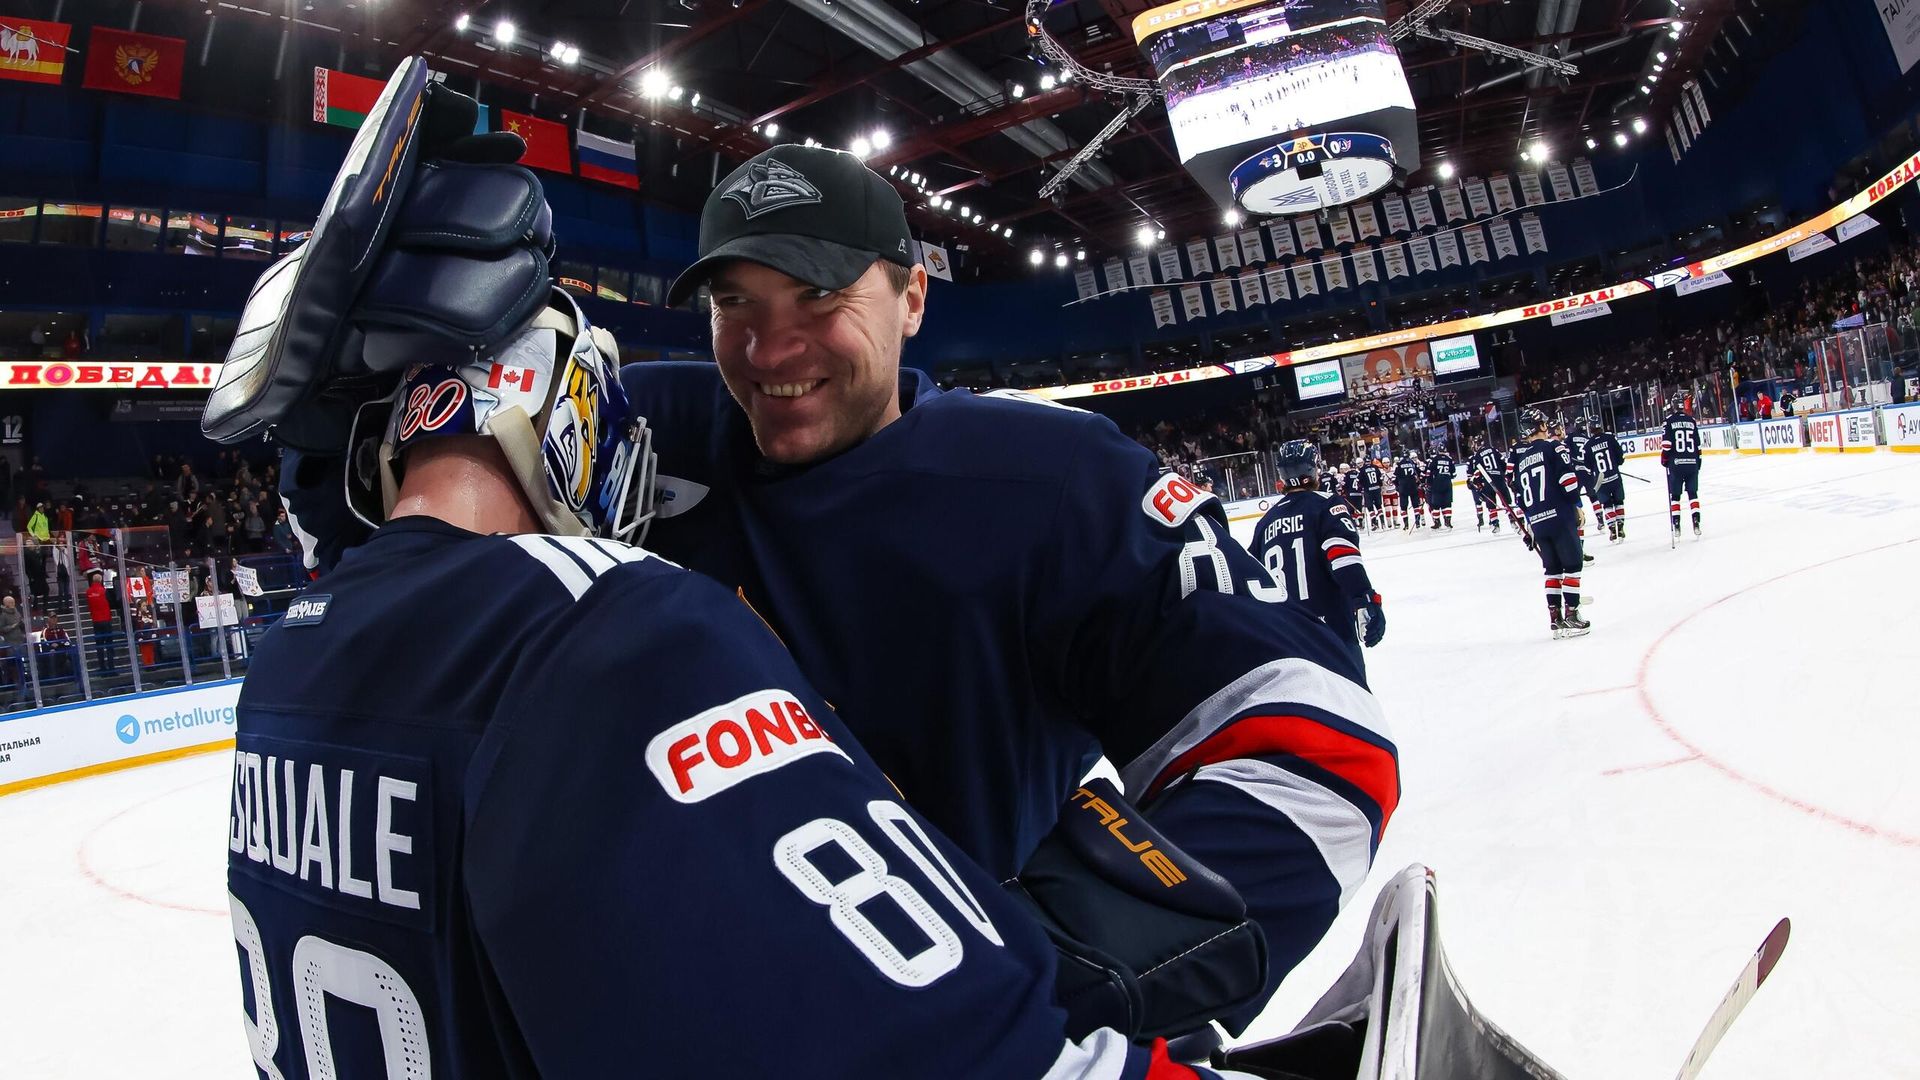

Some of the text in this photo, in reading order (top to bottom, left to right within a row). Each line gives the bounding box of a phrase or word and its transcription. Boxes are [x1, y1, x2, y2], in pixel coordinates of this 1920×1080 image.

[1297, 151, 1316, 164] 0.0
[1330, 141, 1340, 154] 0
[1272, 154, 1282, 168] 3
[1523, 289, 1614, 318] ПОБЕДА!
[9, 364, 212, 389] ПОБЕДА!
[1092, 371, 1191, 393] ПОБЕДА!
[400, 378, 467, 441] 80
[2, 415, 23, 439] 12
[1800, 421, 1834, 443] NBET
[1909, 419, 1920, 435] АУ
[1675, 430, 1695, 453] 85
[1483, 454, 1498, 470] 91
[1595, 449, 1613, 473] 61
[1367, 471, 1378, 485] 18
[1520, 465, 1546, 507] 87
[1264, 515, 1304, 544] LEIPSIC
[1265, 537, 1309, 600] 81
[668, 701, 833, 794] FONB
[1075, 787, 1187, 889] TRUE
[773, 800, 1005, 989] 80
